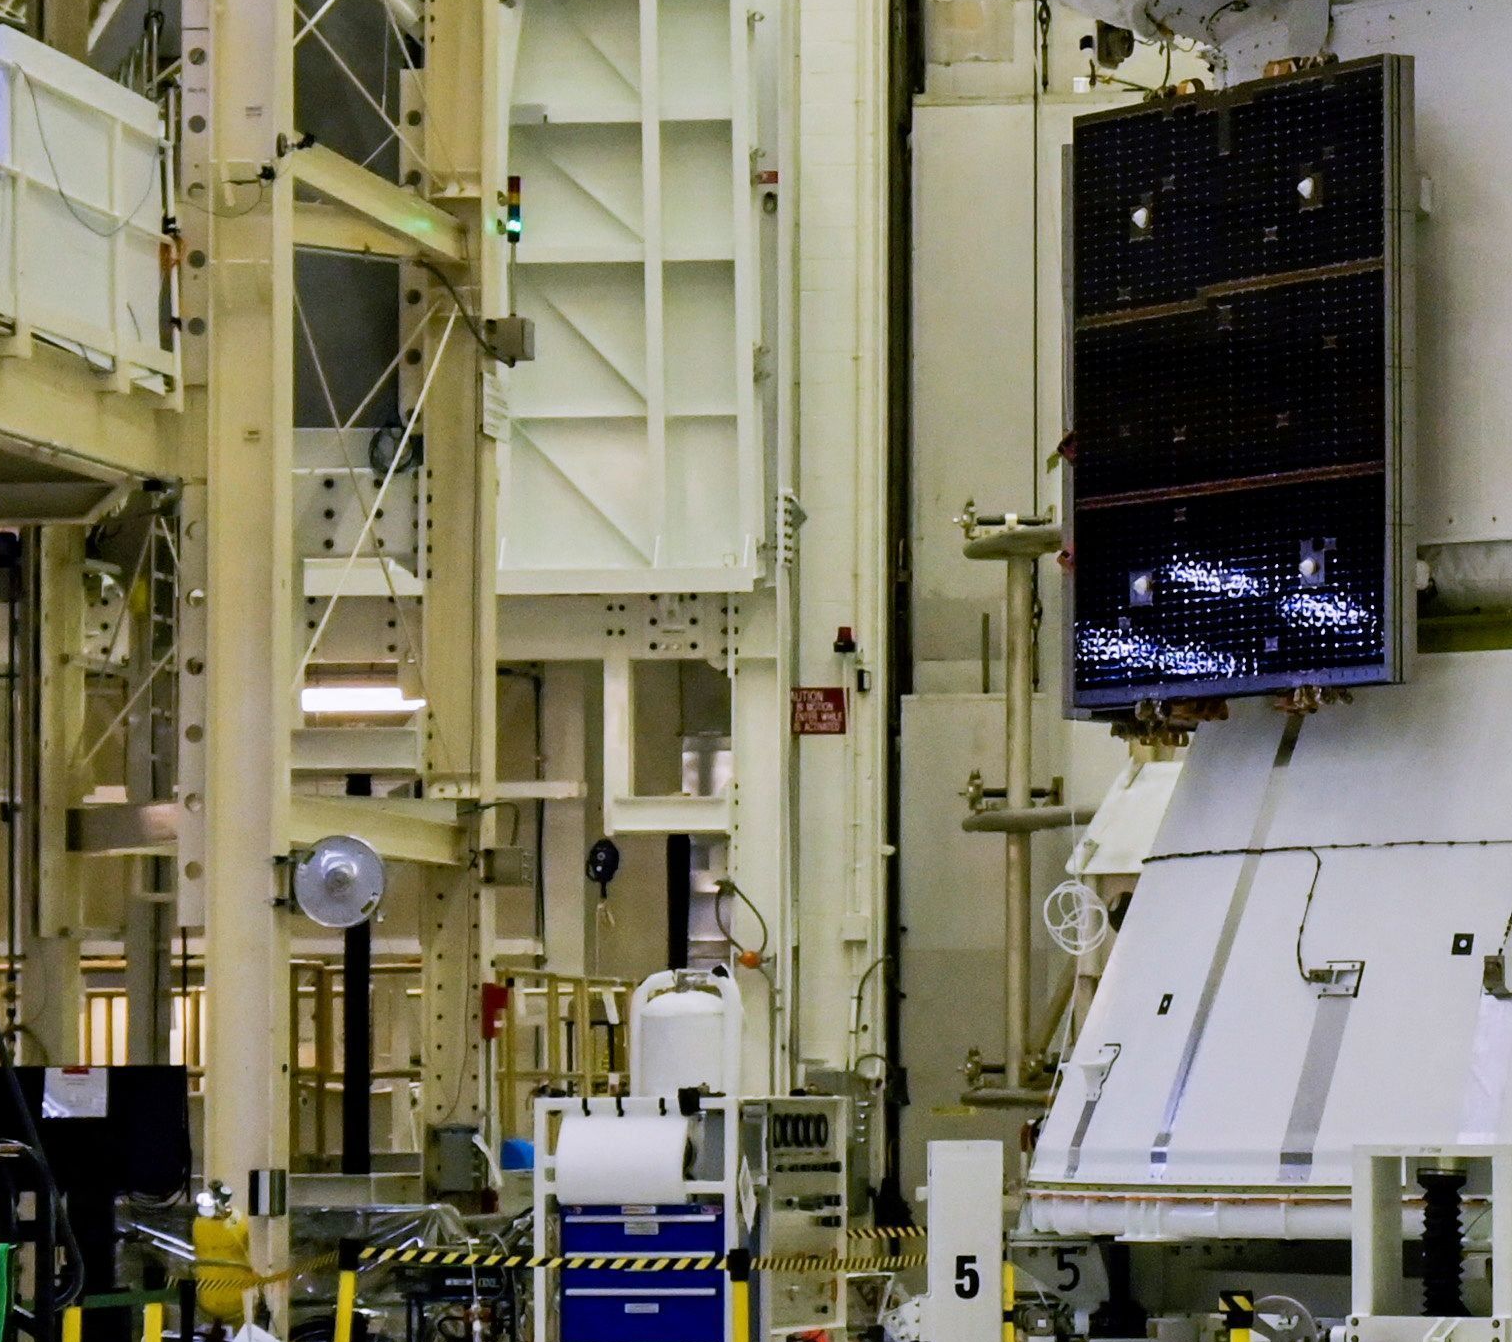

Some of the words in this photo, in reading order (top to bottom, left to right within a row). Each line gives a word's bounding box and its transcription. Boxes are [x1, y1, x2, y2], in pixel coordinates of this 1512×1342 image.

[791, 691, 823, 701] AUTION
[955, 1255, 980, 1299] 5
[1057, 1248, 1081, 1292] 5
